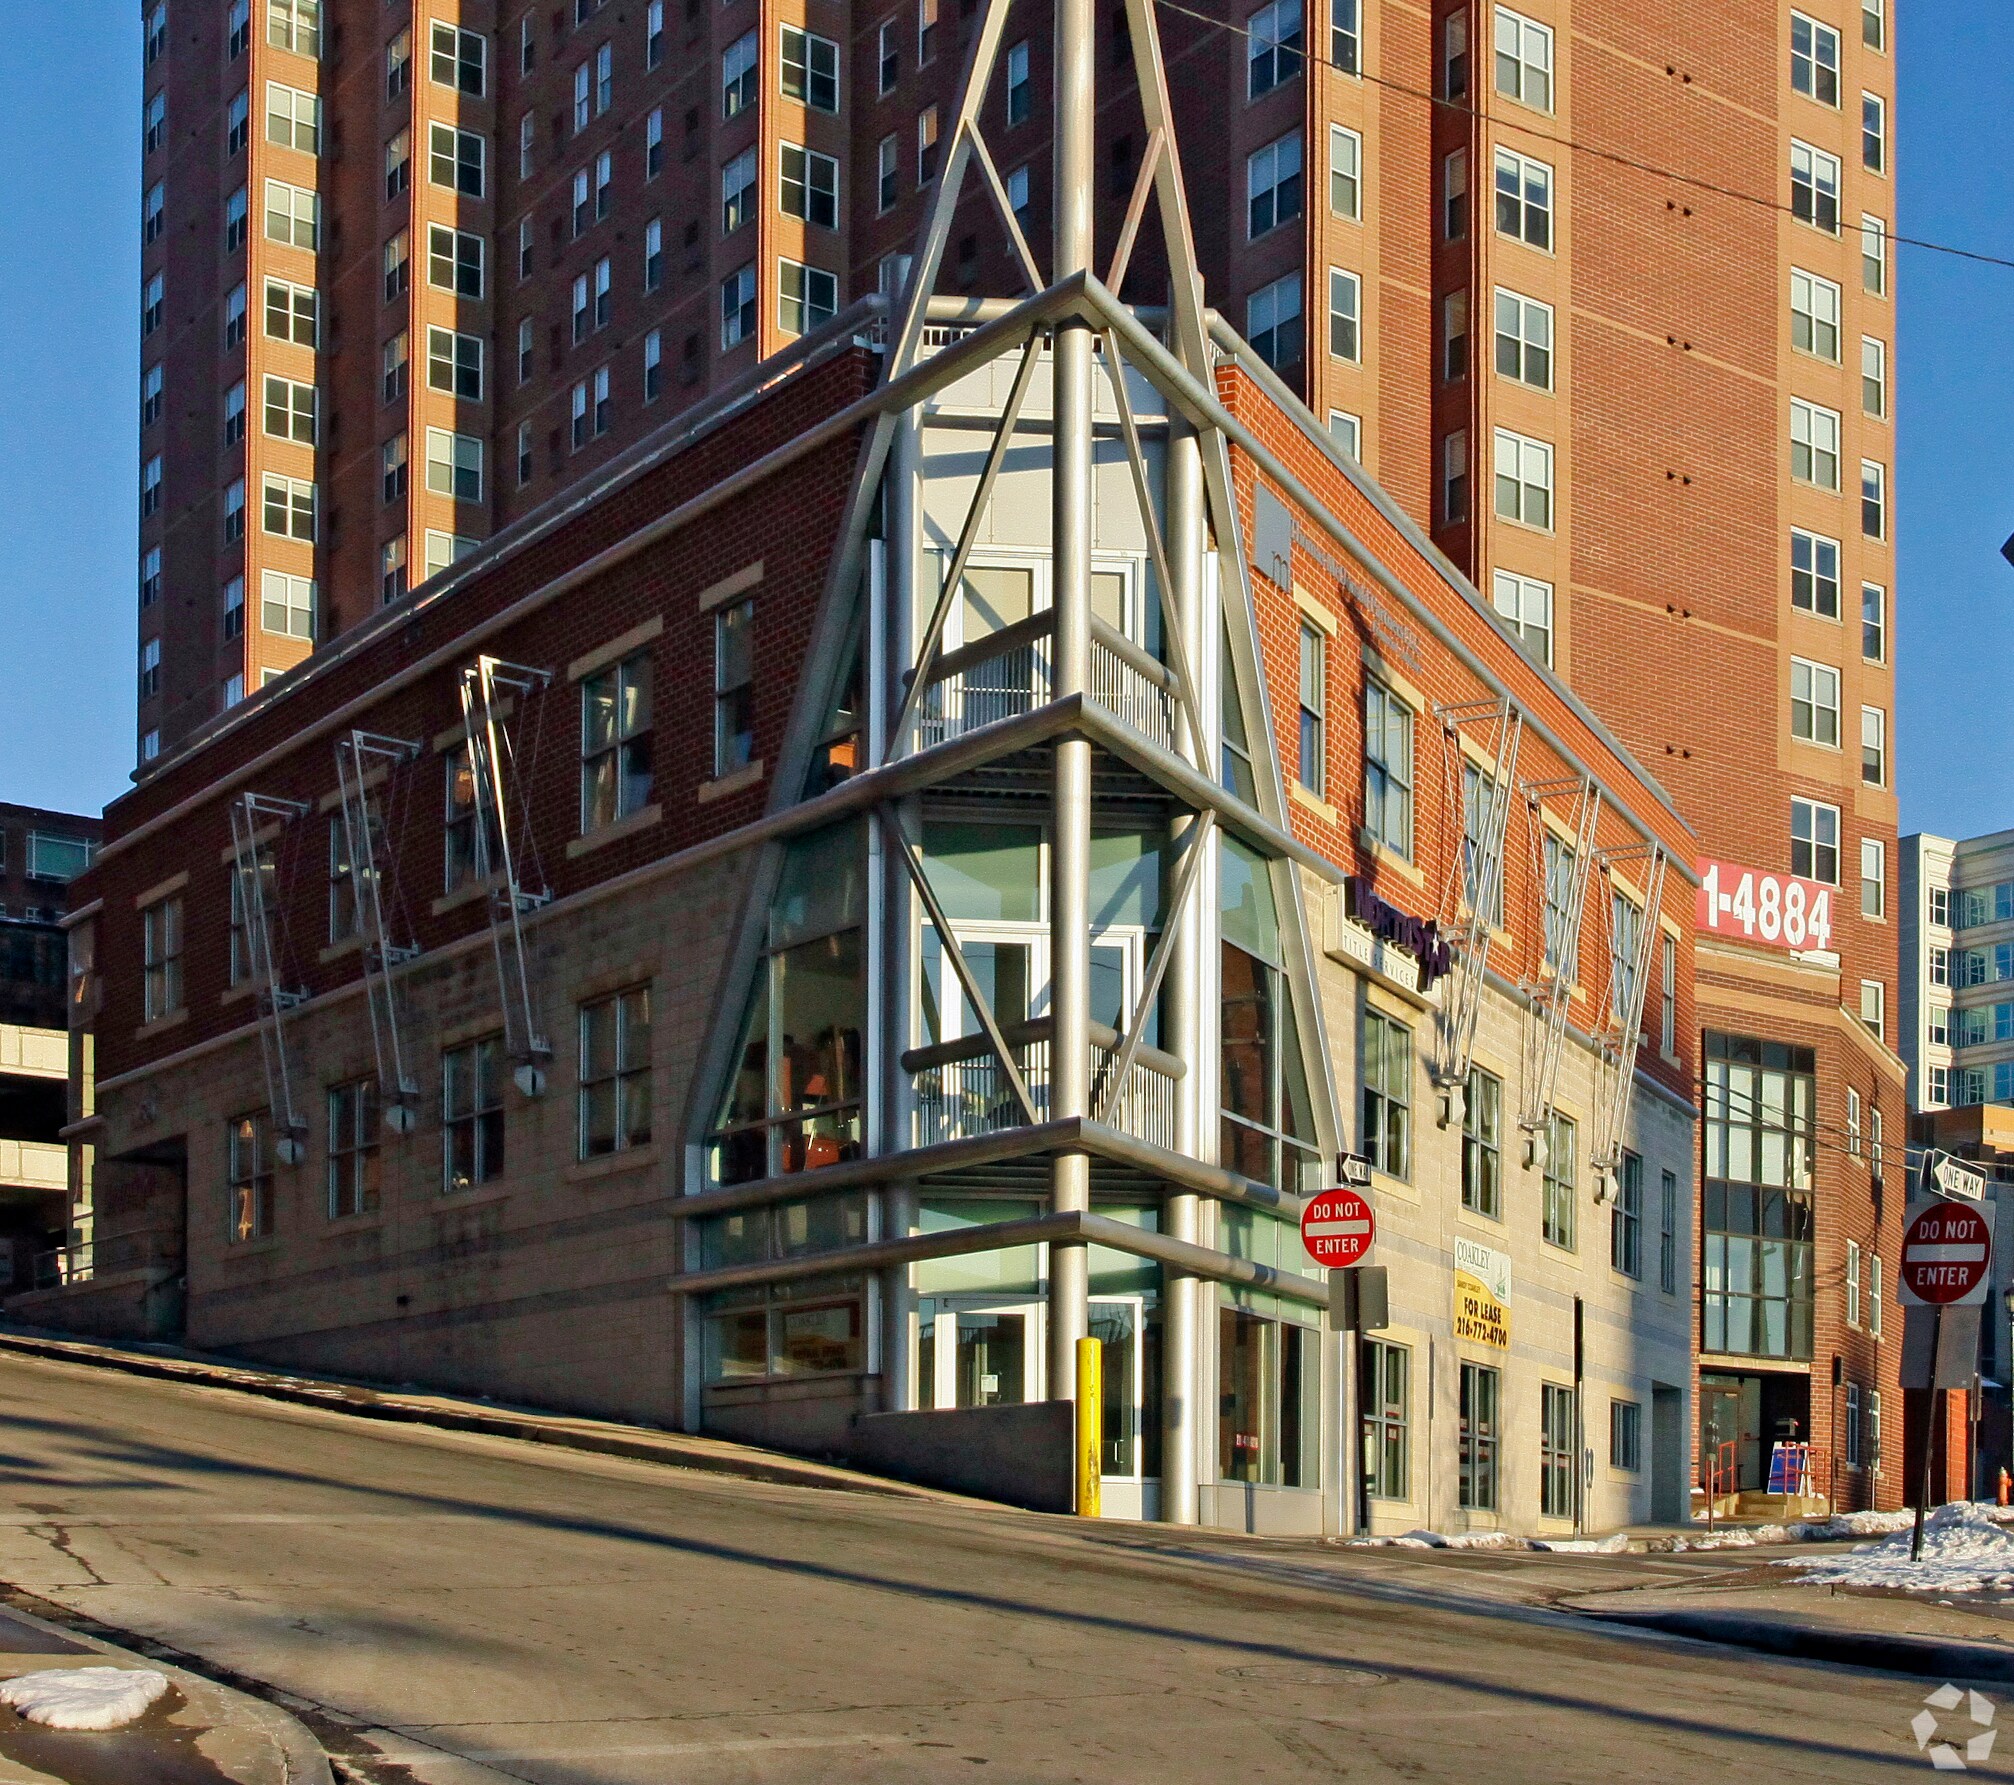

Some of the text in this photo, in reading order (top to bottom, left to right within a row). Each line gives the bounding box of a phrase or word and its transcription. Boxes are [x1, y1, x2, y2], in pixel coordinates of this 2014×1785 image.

[1702, 864, 1831, 949] 1-4884
[1344, 935, 1414, 987] TITLE SERVICES
[1943, 1167, 1980, 1196] ONE WAY
[1313, 1202, 1361, 1219] DO NOT
[1919, 1220, 1977, 1239] DO NOT
[1316, 1238, 1359, 1255] ENTER
[1457, 1241, 1491, 1270] COAKLEY
[1917, 1267, 1968, 1285] ENTER
[1464, 1297, 1502, 1325] FOR LEASE
[1456, 1316, 1507, 1347] 216-772-4700
